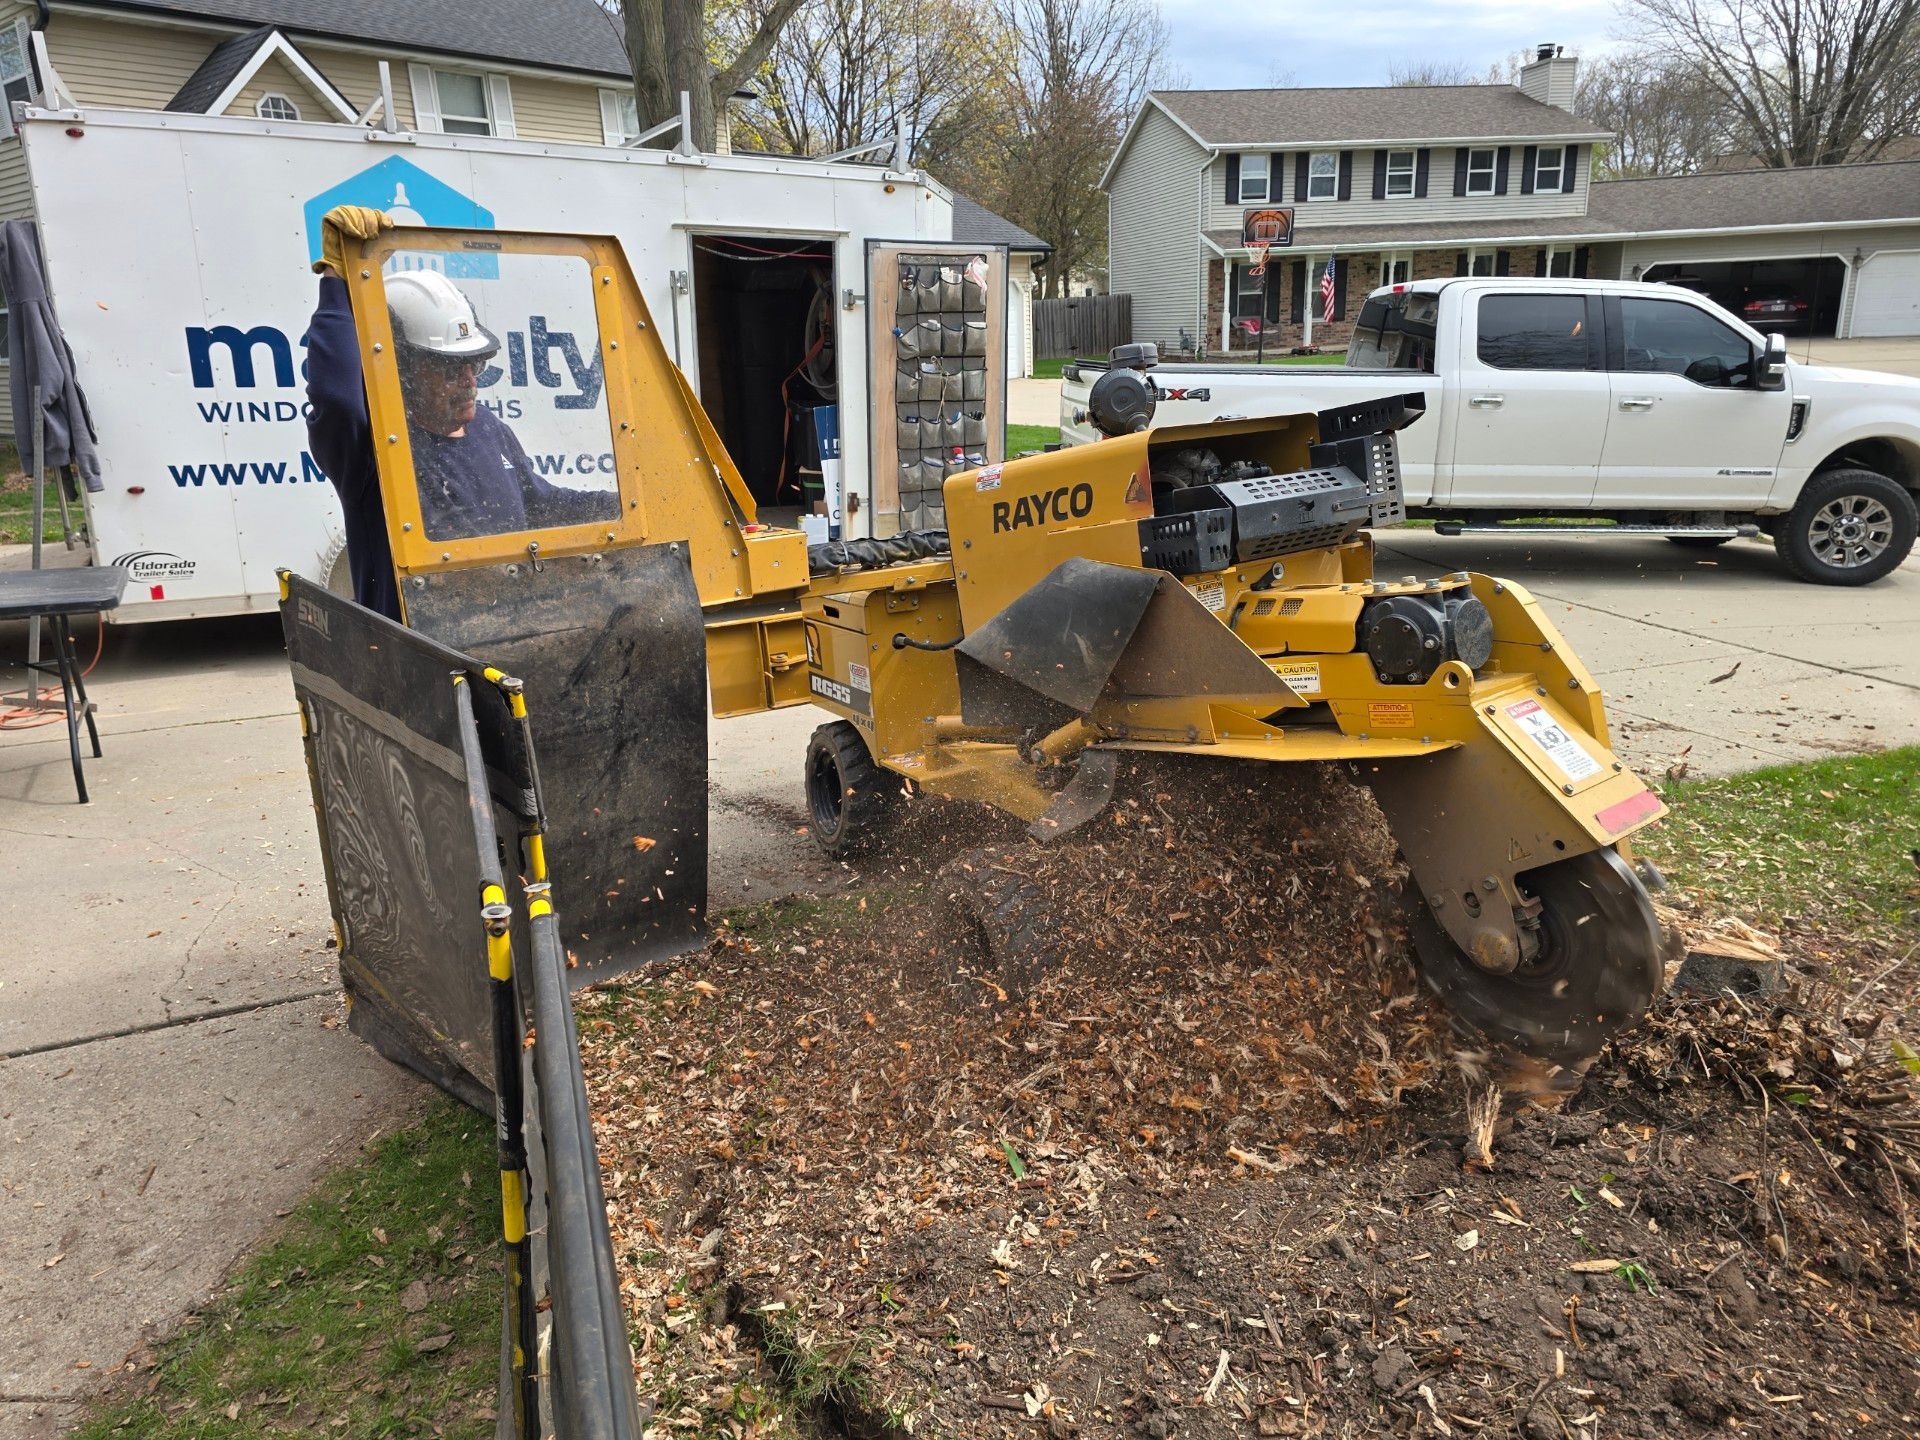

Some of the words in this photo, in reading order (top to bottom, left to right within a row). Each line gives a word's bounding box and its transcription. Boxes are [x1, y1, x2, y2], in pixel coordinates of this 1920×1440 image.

[993, 483, 1093, 534] RAYCO
[133, 560, 196, 571] Eldorado
[1284, 666, 1316, 674] CAUTION
[811, 675, 851, 704] RG55
